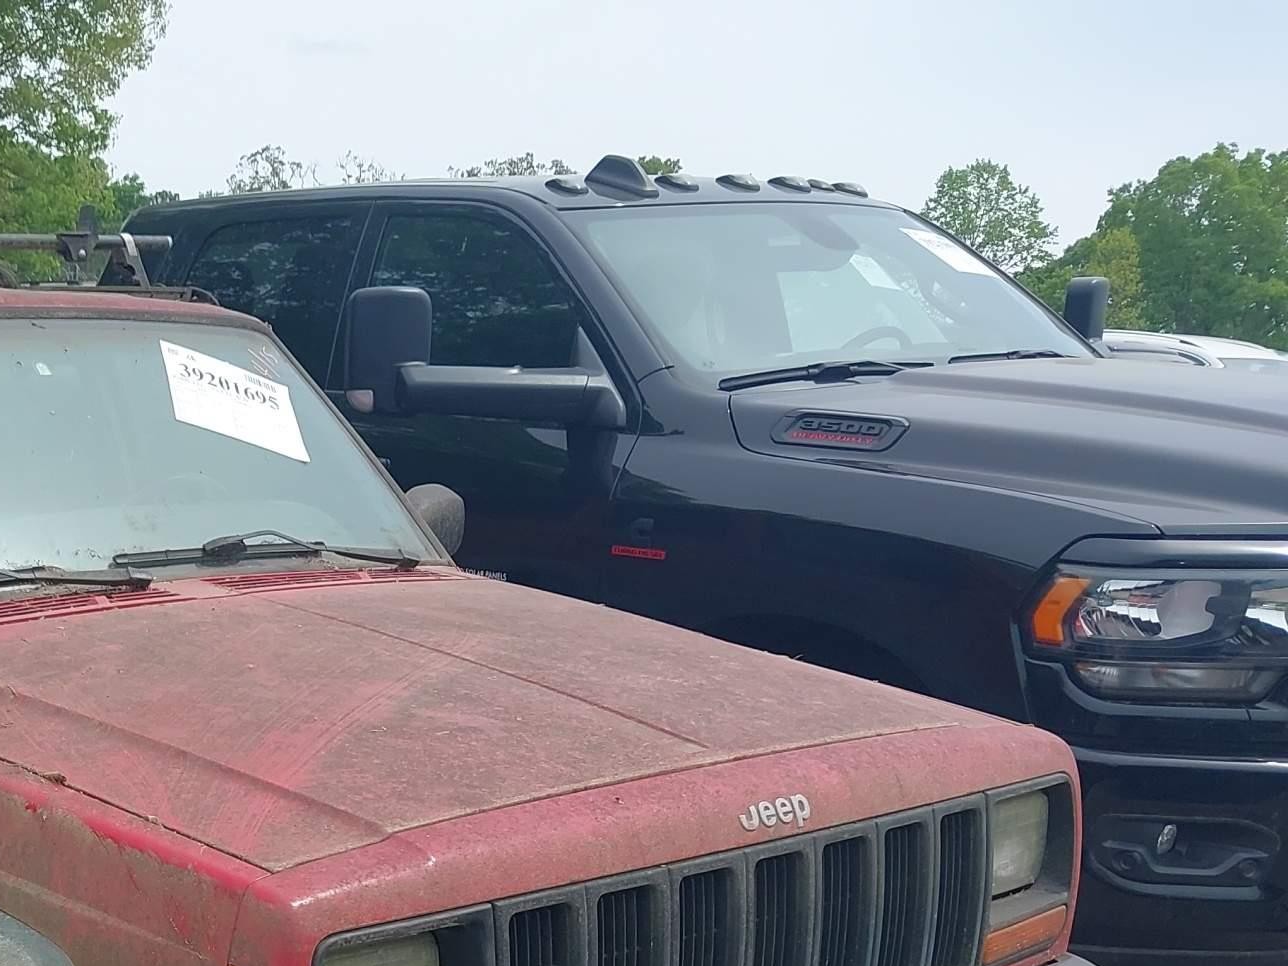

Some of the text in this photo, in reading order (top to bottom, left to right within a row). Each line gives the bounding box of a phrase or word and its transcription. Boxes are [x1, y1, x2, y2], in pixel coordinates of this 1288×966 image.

[178, 363, 280, 410] 39201695
[798, 419, 883, 437] 3500
[738, 794, 811, 832] Jeep
